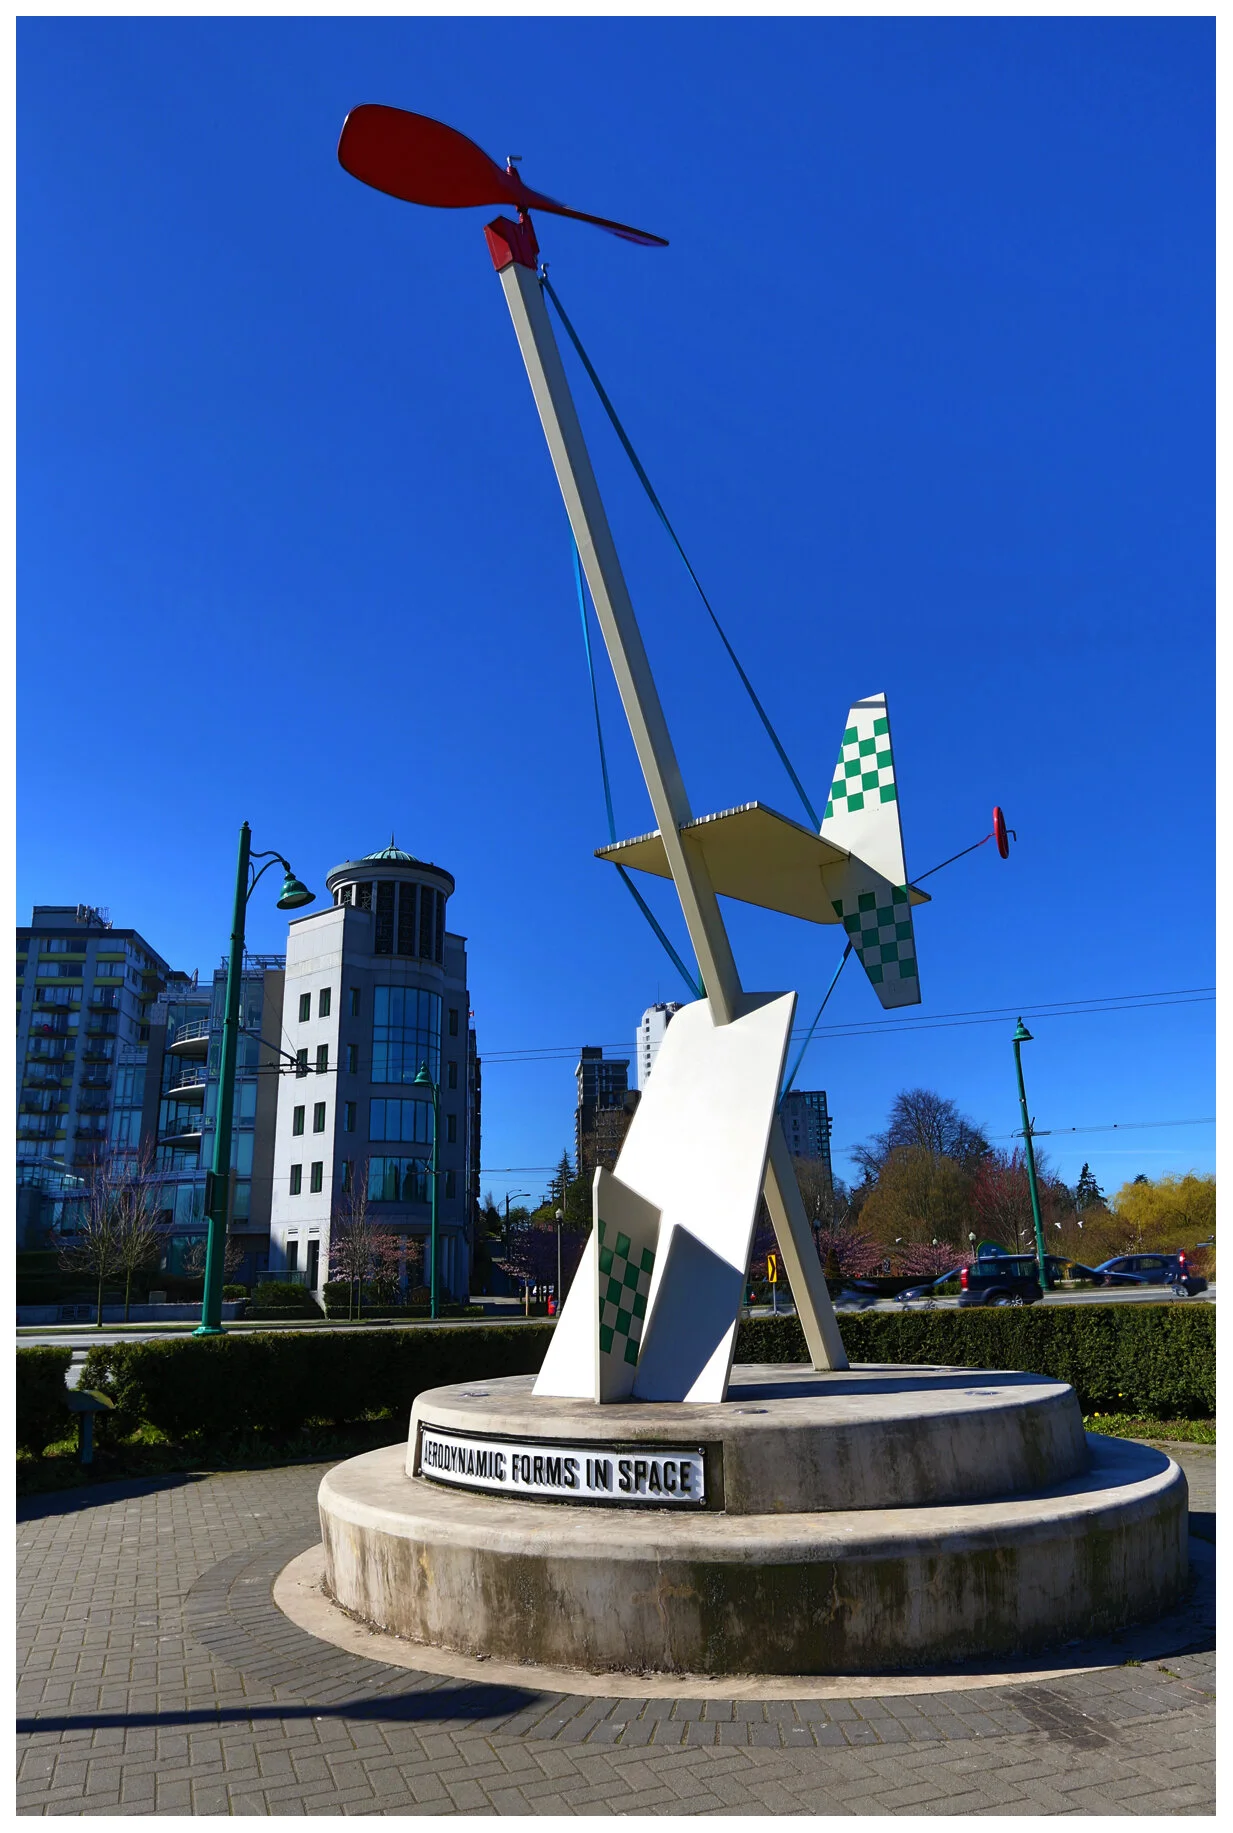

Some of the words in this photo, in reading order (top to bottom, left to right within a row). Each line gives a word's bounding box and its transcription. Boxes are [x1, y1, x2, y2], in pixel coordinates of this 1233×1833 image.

[424, 1439, 504, 1480] AERODYNAMIC
[511, 1453, 577, 1487] FORMS
[586, 1458, 609, 1490] IN
[618, 1459, 692, 1492] SPACE
